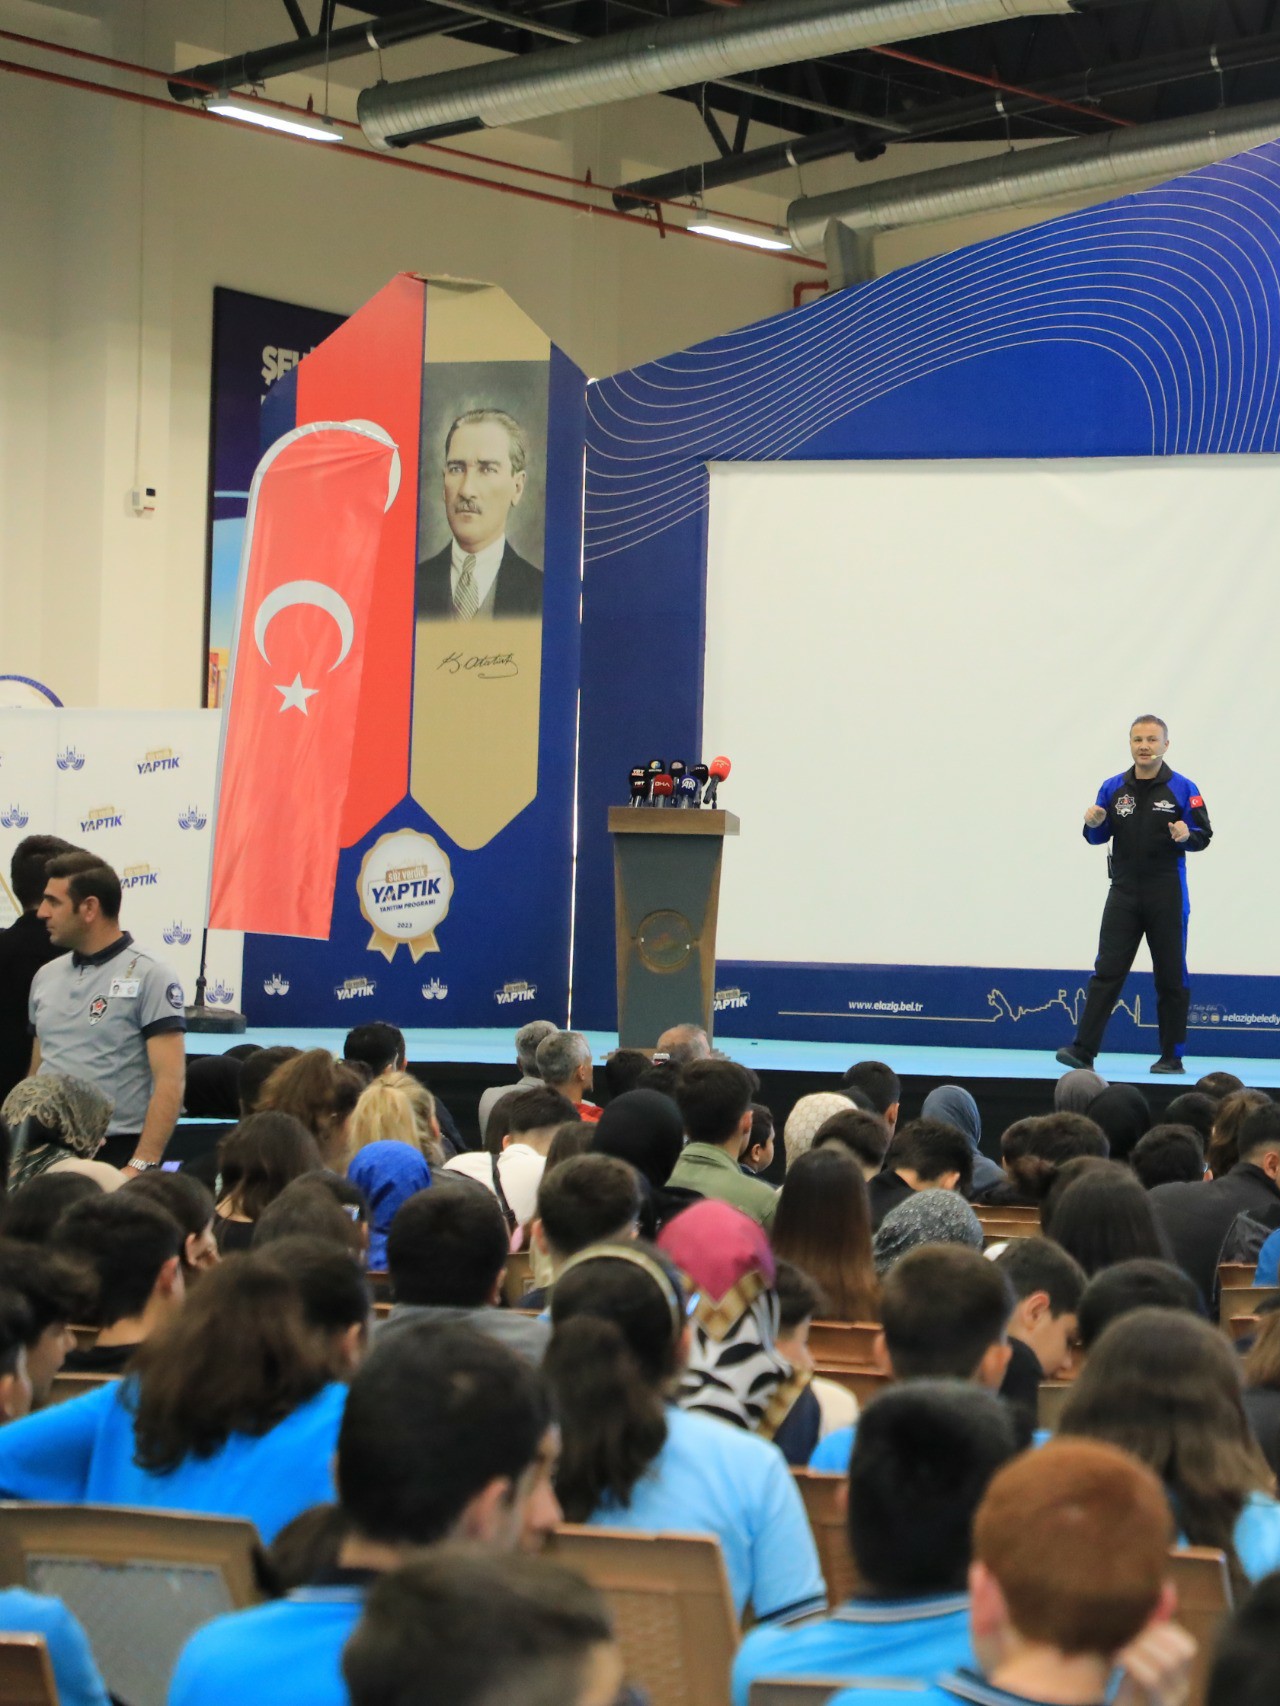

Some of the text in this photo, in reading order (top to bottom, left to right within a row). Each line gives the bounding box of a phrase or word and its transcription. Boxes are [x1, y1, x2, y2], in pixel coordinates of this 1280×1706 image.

[137, 757, 180, 774] YAPTIK
[80, 815, 123, 832] YAPTIK
[372, 877, 441, 904] YAPTIK
[336, 984, 375, 1000] YAPTIK
[496, 989, 536, 1004] YAPTIK
